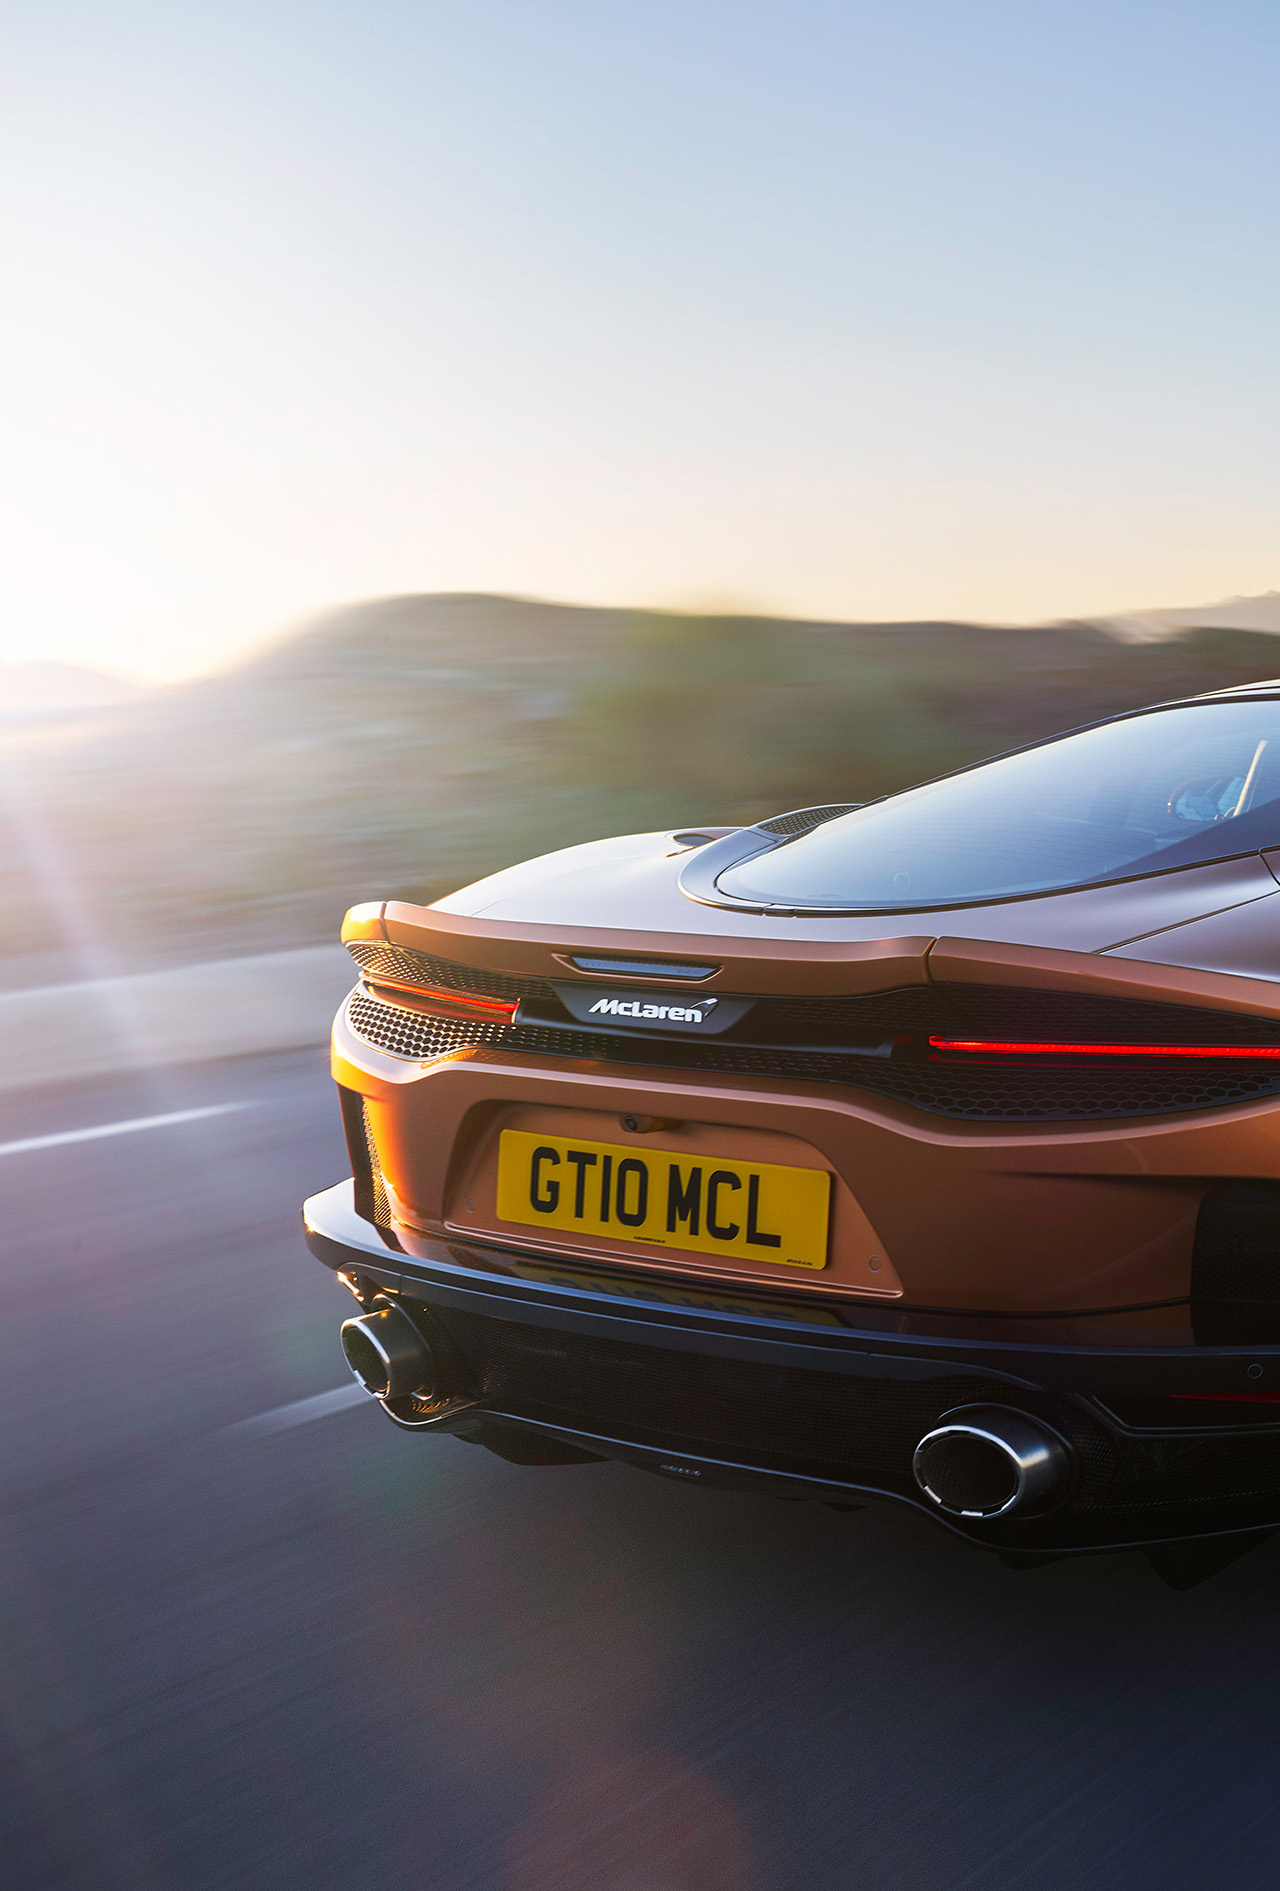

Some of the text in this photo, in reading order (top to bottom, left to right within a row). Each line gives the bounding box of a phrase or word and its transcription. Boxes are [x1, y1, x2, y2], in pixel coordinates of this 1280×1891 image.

[588, 998, 703, 1023] McLaren
[530, 1146, 782, 1248] GT10 MCL
